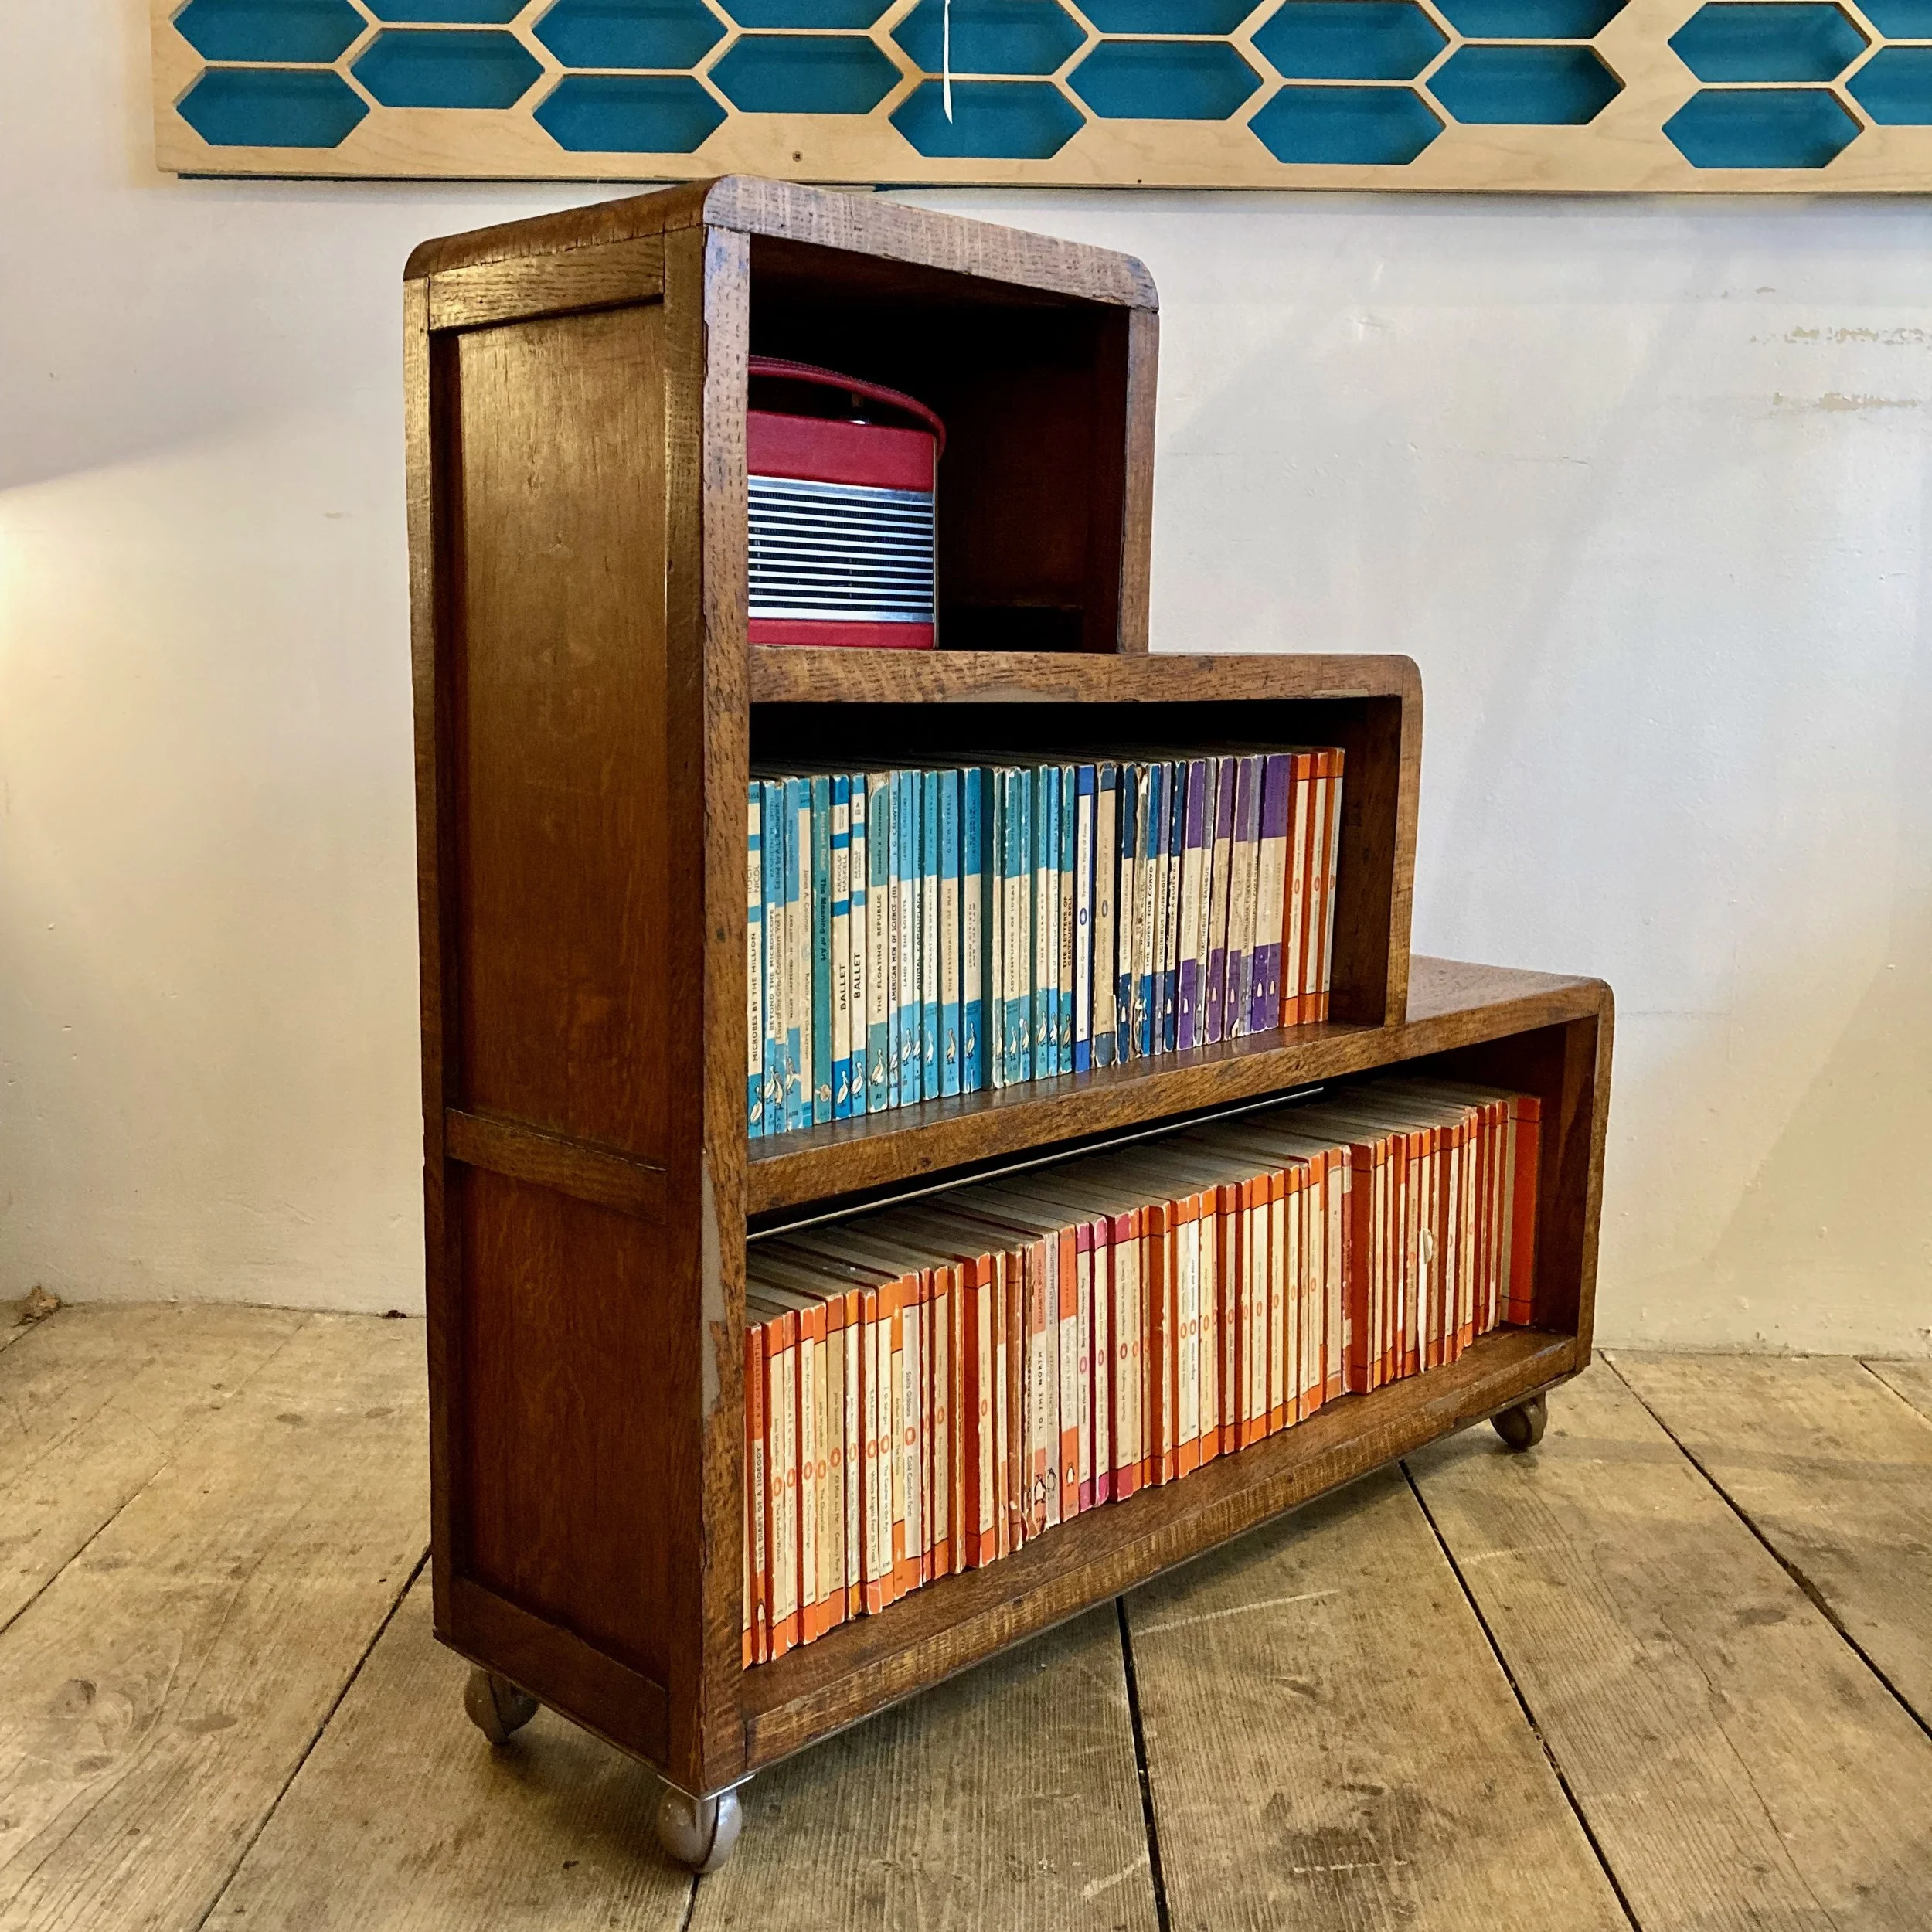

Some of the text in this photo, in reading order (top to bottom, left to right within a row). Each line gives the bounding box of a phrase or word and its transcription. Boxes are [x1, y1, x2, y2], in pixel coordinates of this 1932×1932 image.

[774, 855, 781, 865] by
[1063, 896, 1067, 908] OF
[947, 910, 952, 920] OF
[1010, 916, 1015, 927] OF
[820, 937, 827, 946] of
[891, 934, 897, 944] OF
[903, 951, 907, 962] OF
[838, 963, 847, 1011] BALLET
[751, 1001, 757, 1012] BY
[775, 1011, 782, 1020] of
[1038, 1417, 1043, 1430] TO
[757, 1501, 763, 1512] OF
